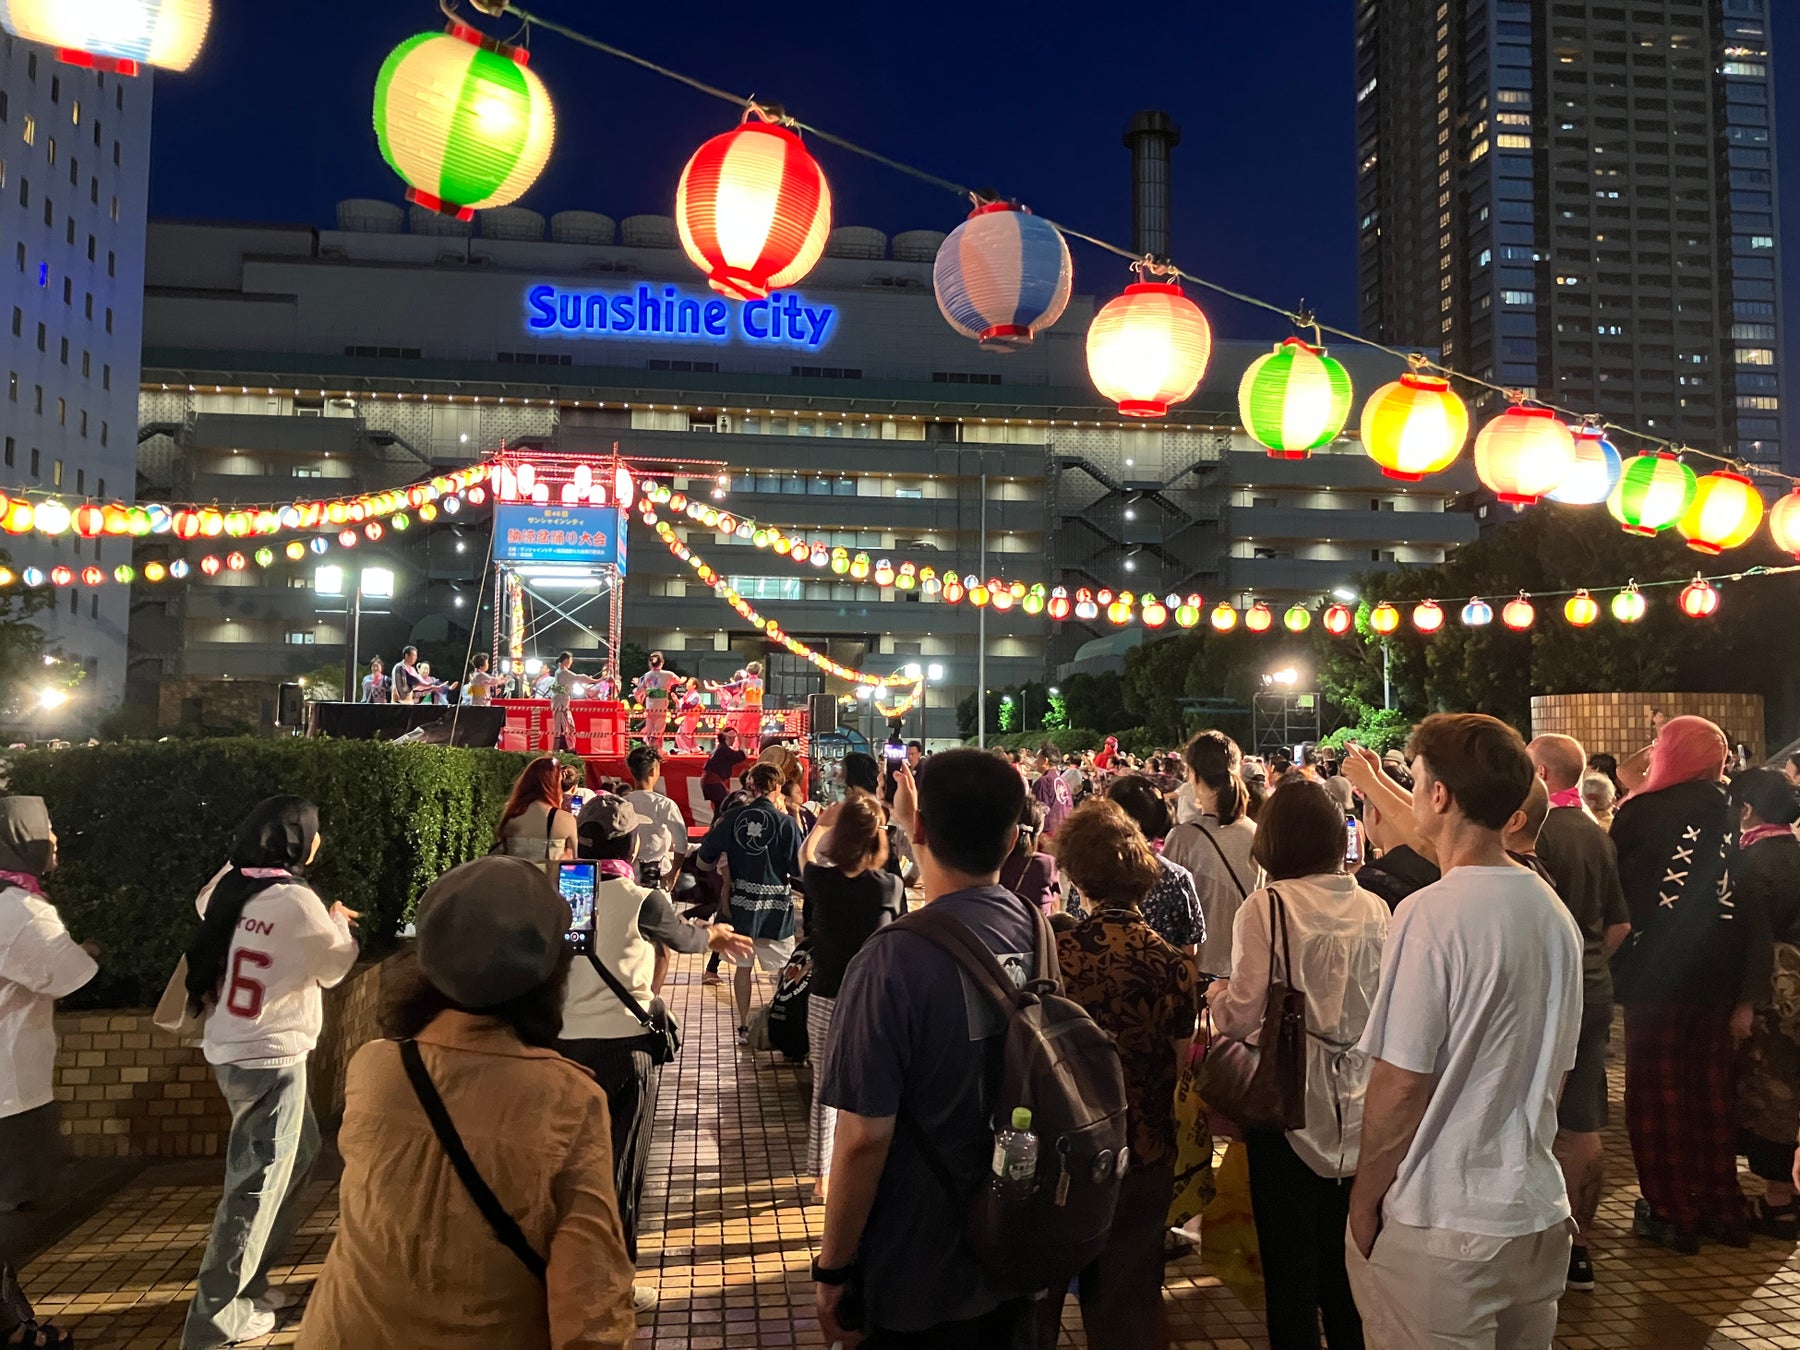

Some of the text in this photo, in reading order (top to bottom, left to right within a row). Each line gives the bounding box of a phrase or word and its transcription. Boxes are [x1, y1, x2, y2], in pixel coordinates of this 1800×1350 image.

[528, 284, 833, 345] Sunshine City
[507, 528, 607, 547] 納涼盆踊り大会
[527, 516, 585, 526] サンシャインシティ
[226, 946, 273, 1020] 6
